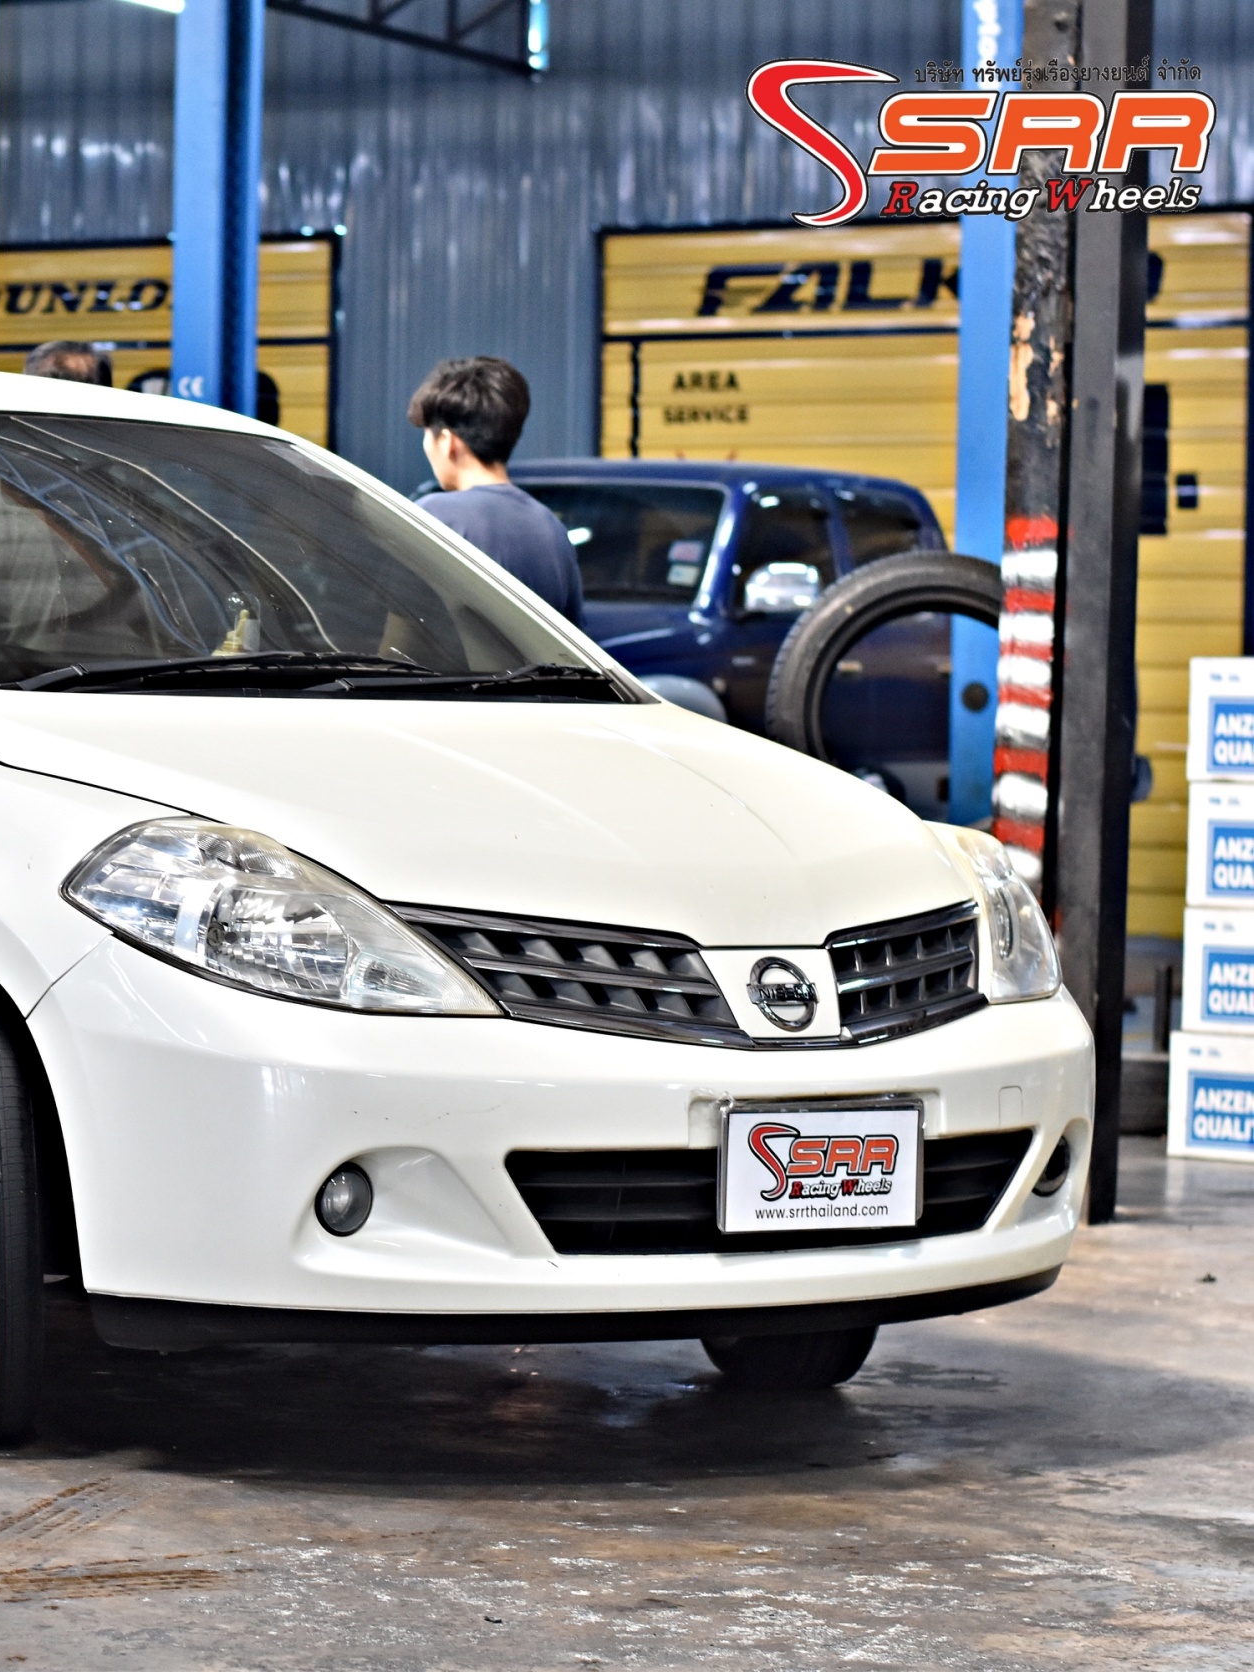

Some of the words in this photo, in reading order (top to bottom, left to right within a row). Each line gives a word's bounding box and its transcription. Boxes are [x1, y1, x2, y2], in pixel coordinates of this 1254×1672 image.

[672, 371, 741, 393] AREA
[663, 404, 749, 425] SERVICE
[789, 1180, 841, 1200] Racing
[841, 1178, 893, 1196] Wheels
[755, 1204, 889, 1219] www.srrthailand.com
